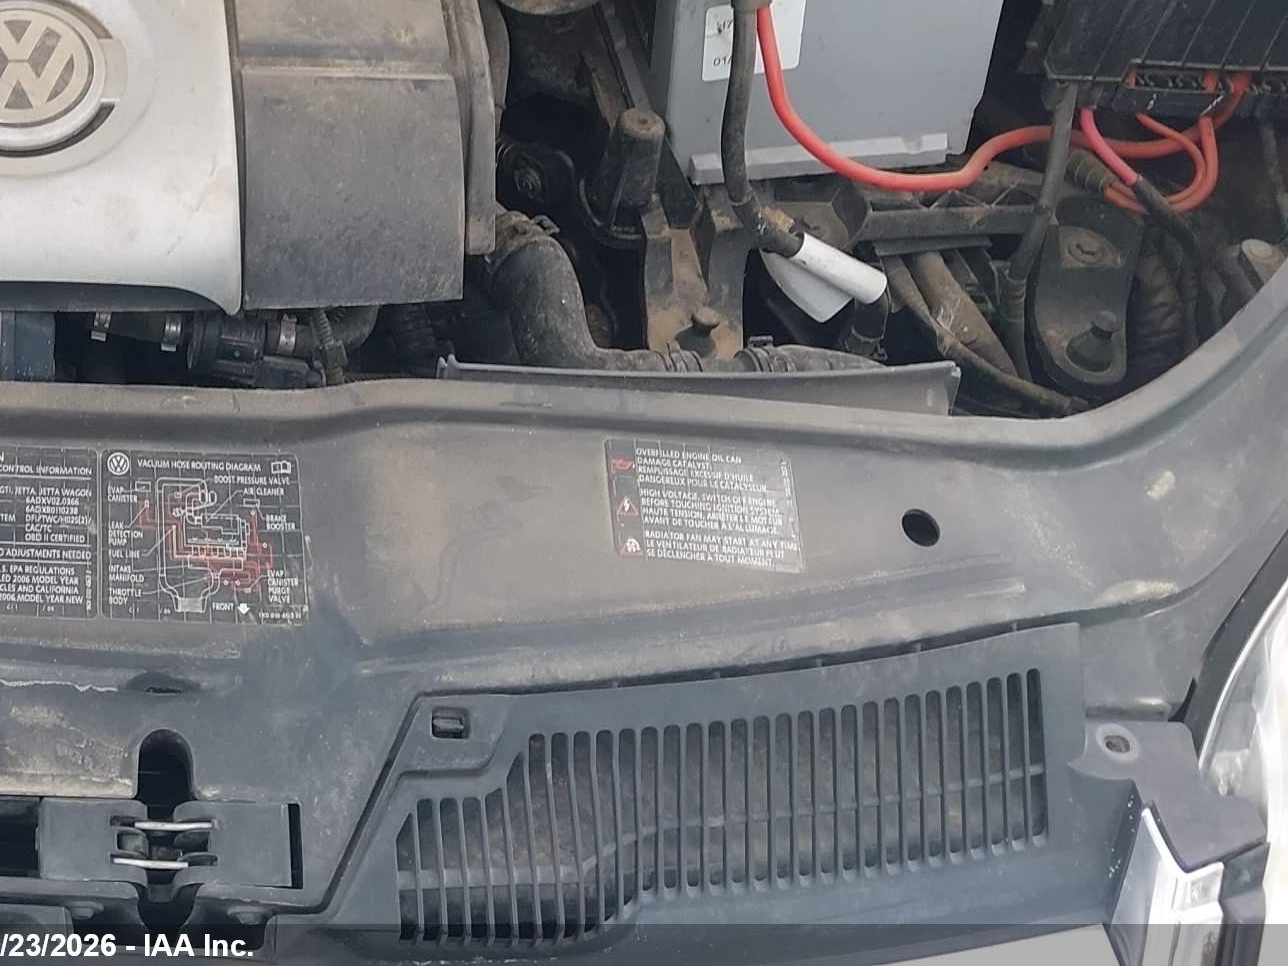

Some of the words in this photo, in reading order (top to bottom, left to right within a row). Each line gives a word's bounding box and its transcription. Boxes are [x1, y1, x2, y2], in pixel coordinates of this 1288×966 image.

[635, 447, 680, 458] OVERFILLED
[725, 455, 742, 463] CAN
[138, 459, 169, 468] VACUUM
[171, 461, 190, 469] HOSE
[191, 462, 224, 471] ROUTING
[225, 463, 261, 472] DIAGRAM
[636, 456, 671, 466] DAMAGE
[37, 467, 92, 475] INFORMATION
[214, 475, 235, 483] BOOST
[237, 476, 268, 484] PRESSURE
[269, 477, 290, 485] VALVE
[61, 489, 92, 497] WAGON
[243, 487, 255, 495] AIR
[257, 488, 284, 496] CLEANER
[108, 494, 137, 502] CANISTER
[25, 523, 52, 532] CAC/TC
[25, 534, 42, 542] OBD
[50, 535, 85, 543] CERTIFIED
[108, 530, 143, 538] DETECTION
[108, 537, 127, 546] PUMP
[645, 529, 684, 540] RADIATOR
[703, 535, 721, 544] MAY
[749, 539, 760, 547] AT
[760, 539, 777, 549] ANY
[6, 548, 60, 558] ADJUSTMENTS
[62, 550, 91, 559] NEEDED
[108, 550, 124, 558] FUEL
[10, 565, 23, 573] EPA
[25, 566, 75, 575] REGULATIONS
[13, 575, 30, 583] 2006
[32, 576, 58, 584] MODEL
[60, 576, 79, 584] YEAR
[109, 573, 144, 582] MANIFOLD
[267, 578, 298, 586] CANISTER
[17, 585, 34, 593] AND
[35, 585, 78, 594] CALIFORNIA
[108, 589, 142, 597] THROTTLE
[268, 587, 290, 595] PURGE
[17, 594, 43, 602] MODEL
[44, 595, 64, 603] YEAR
[66, 596, 83, 604] NEW
[109, 596, 128, 605] BODY
[268, 595, 291, 604] VALVE
[213, 602, 234, 611] FRONT
